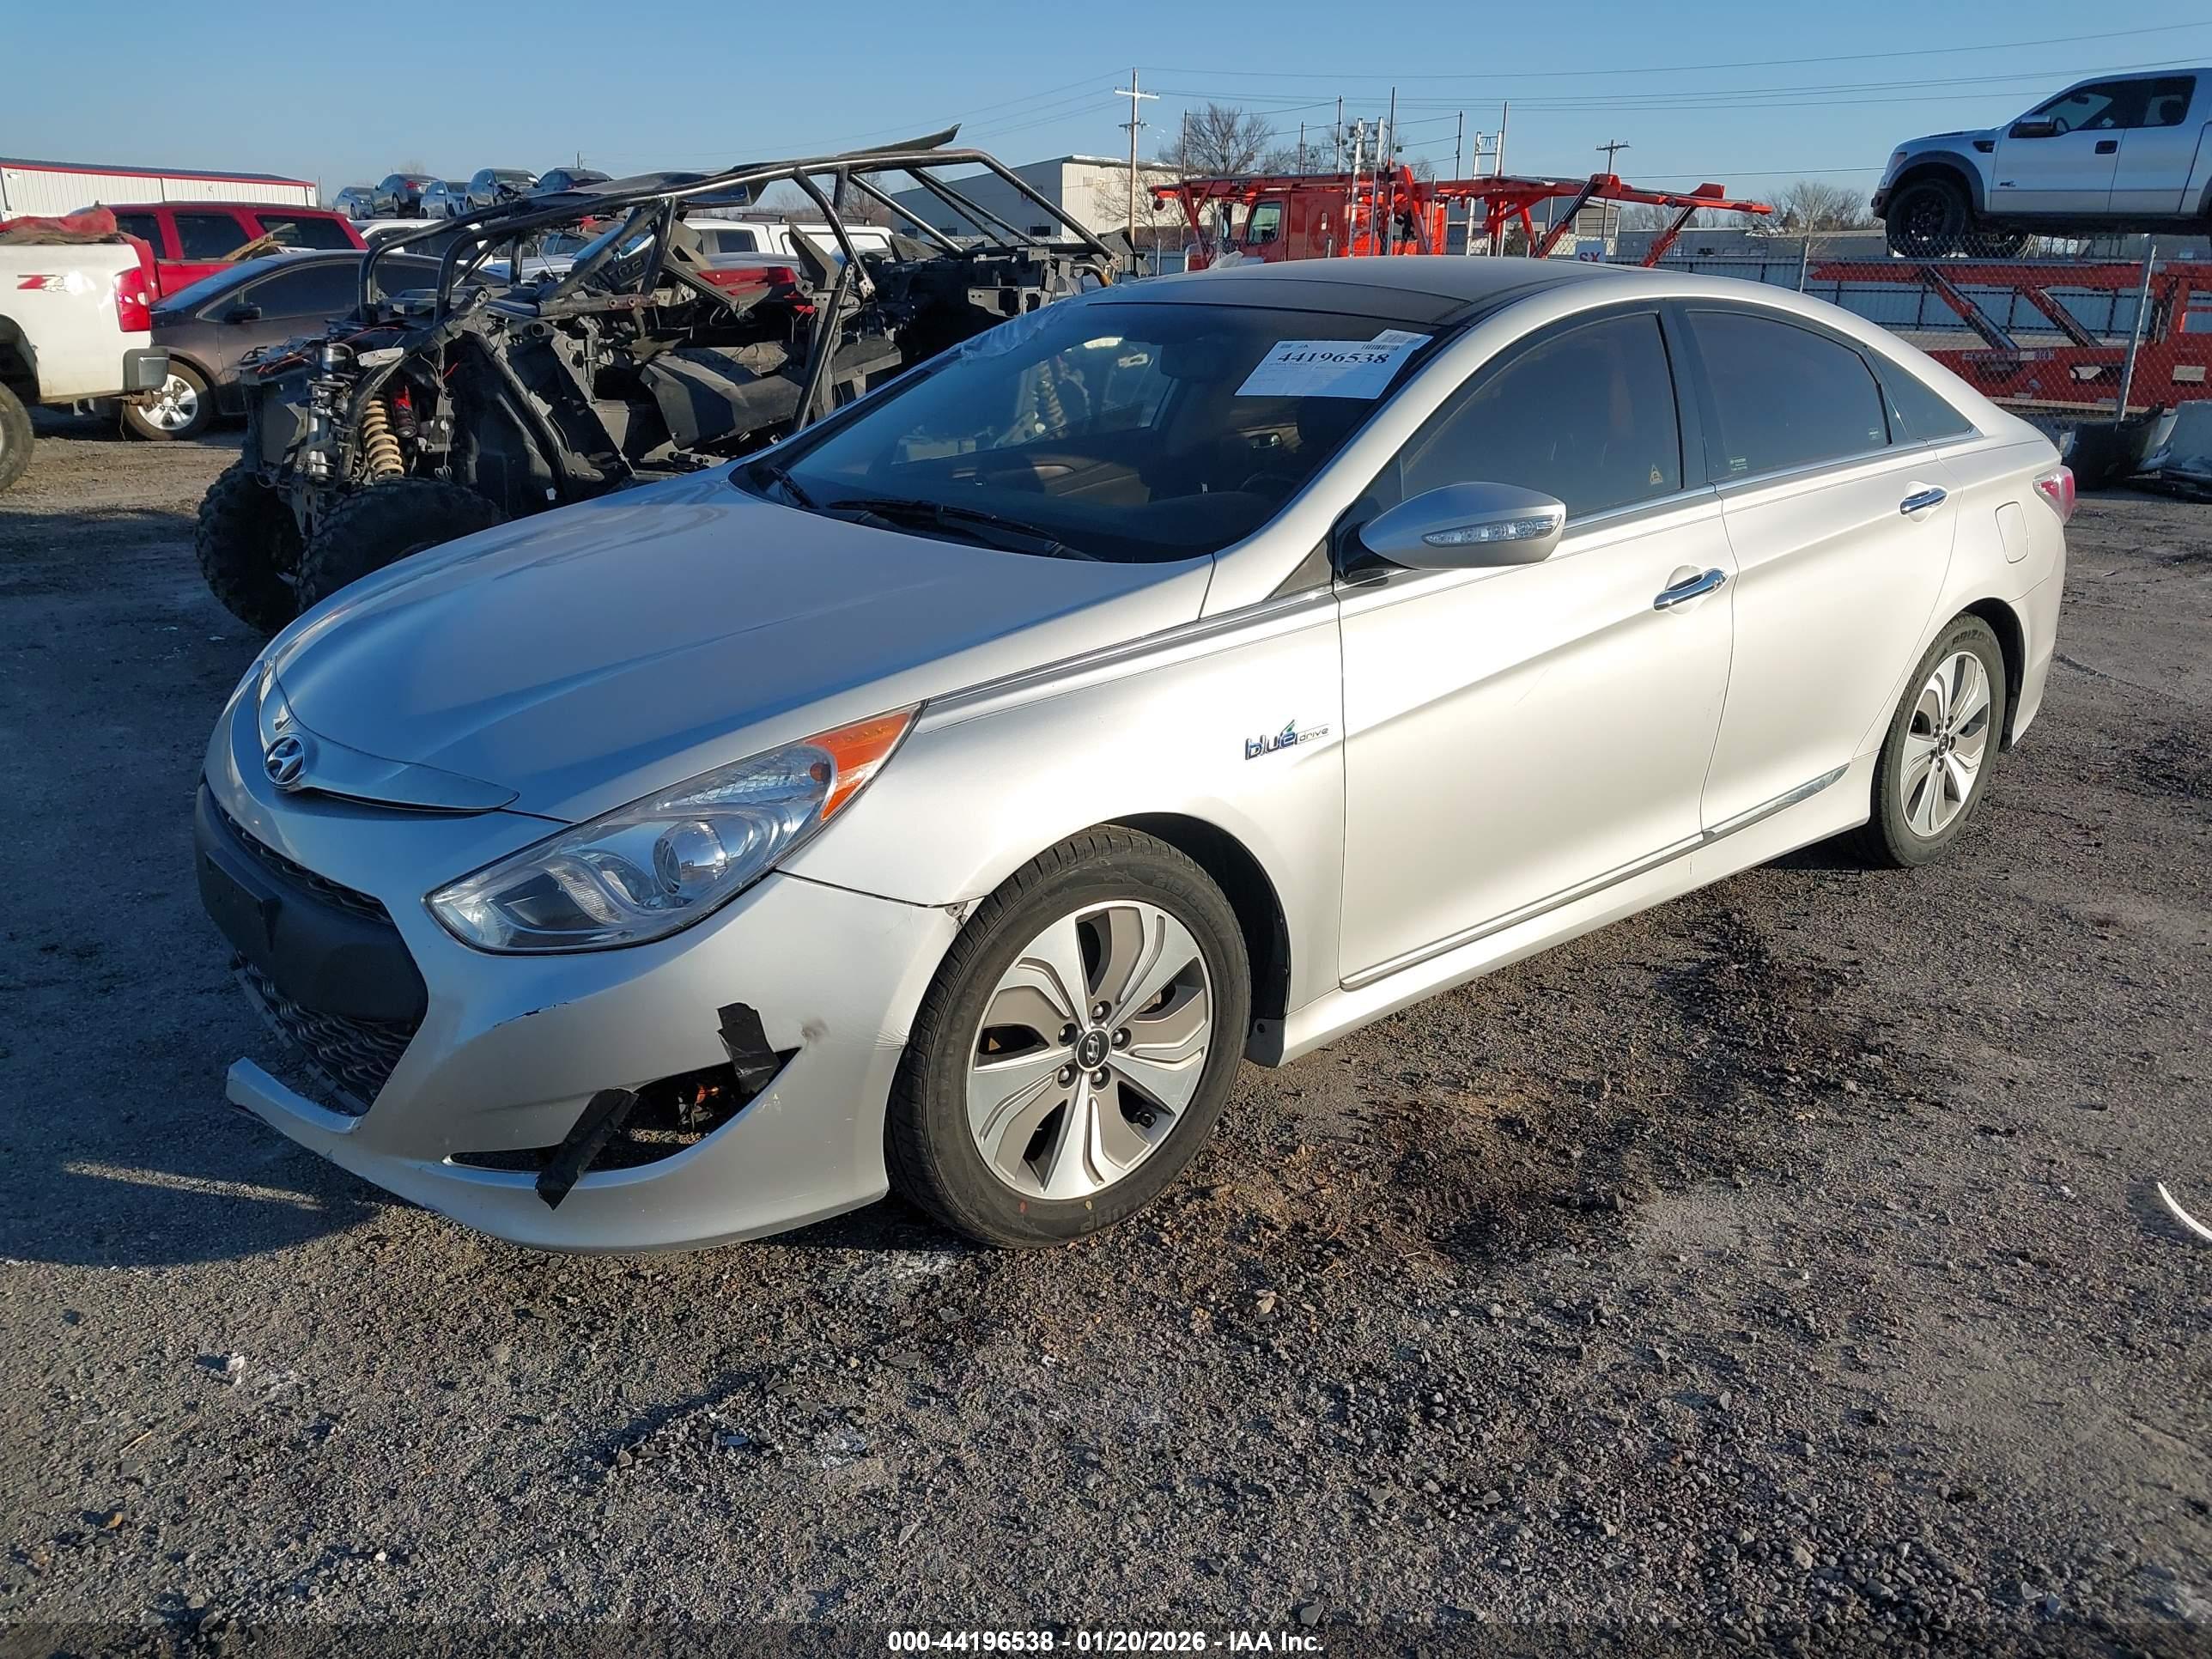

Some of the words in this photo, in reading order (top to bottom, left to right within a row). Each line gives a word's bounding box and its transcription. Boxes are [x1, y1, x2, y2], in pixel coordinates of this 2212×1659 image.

[1277, 351, 1390, 365] 44196538
[1244, 726, 1297, 761] blue
[1299, 727, 1328, 742] drive
